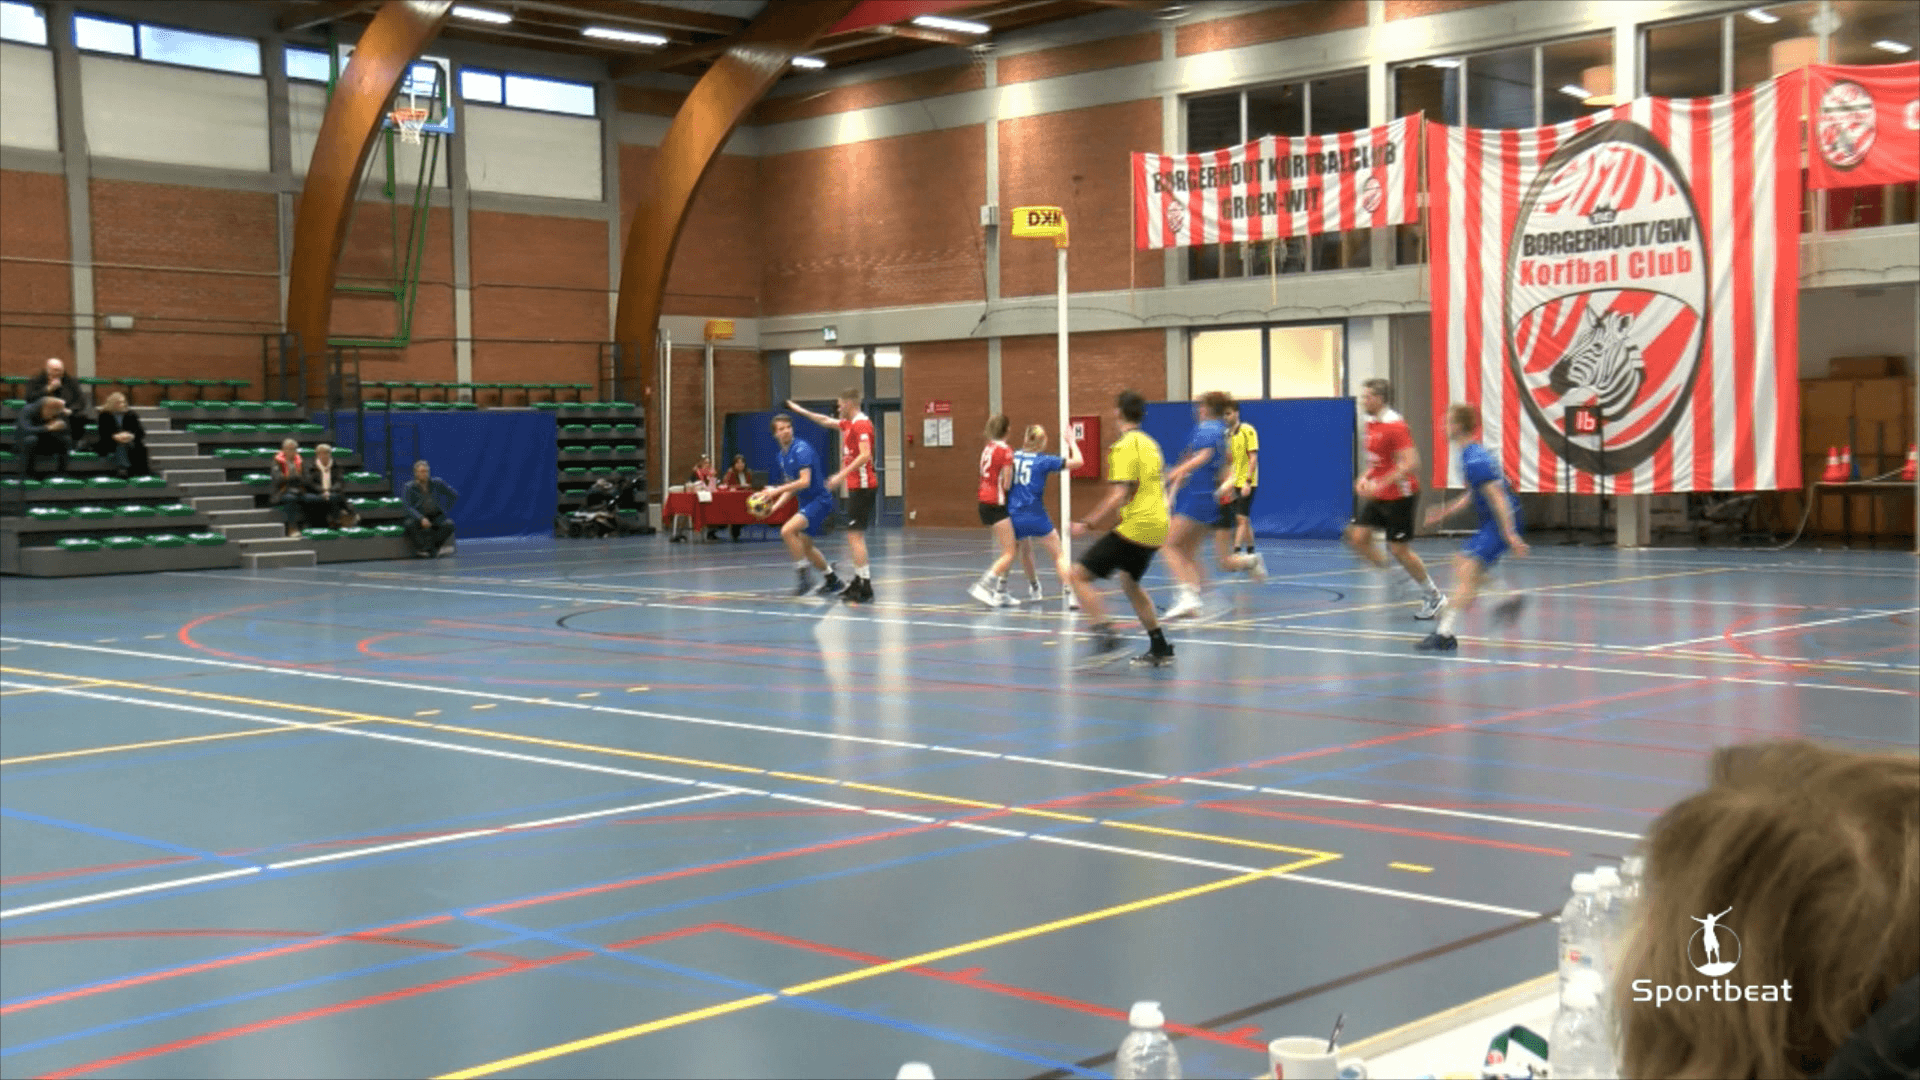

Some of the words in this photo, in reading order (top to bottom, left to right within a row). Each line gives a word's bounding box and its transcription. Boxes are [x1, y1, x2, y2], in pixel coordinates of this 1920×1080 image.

[1153, 158, 1264, 194] BORGERHOUT
[1221, 187, 1321, 220] GROEN-WIT
[1522, 216, 1693, 257] BORGERHOUT/GW
[1520, 254, 1619, 287] Korfbal
[1629, 247, 1693, 280] Club
[1013, 458, 1034, 486] 15
